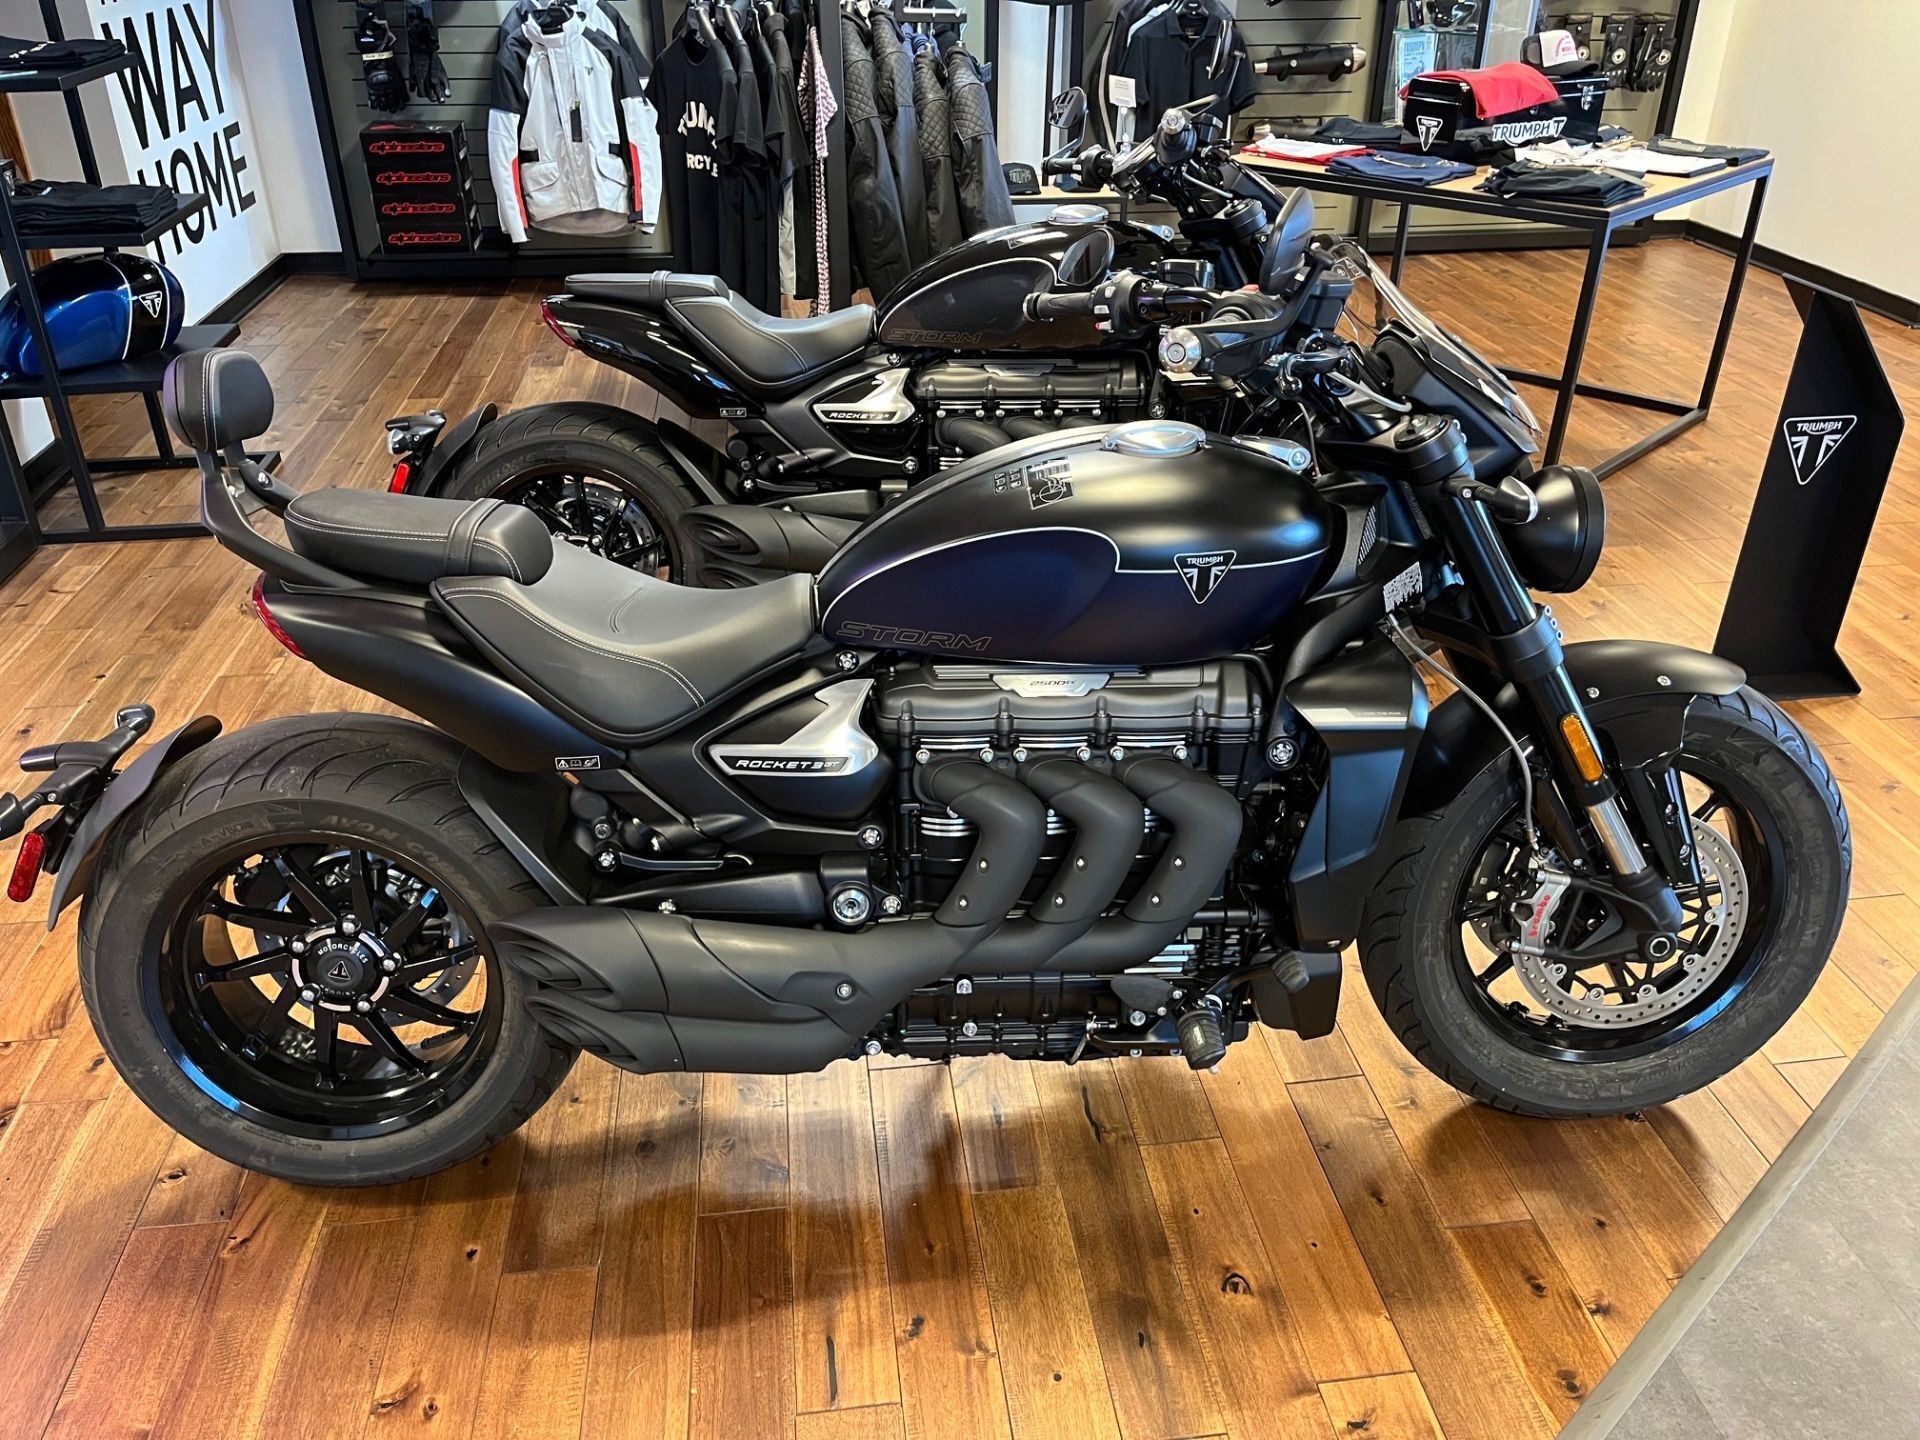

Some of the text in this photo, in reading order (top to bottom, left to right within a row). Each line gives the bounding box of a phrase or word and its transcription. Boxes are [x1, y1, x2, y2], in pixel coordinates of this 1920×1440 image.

[101, 0, 225, 151] WAY
[1492, 121, 1550, 146] TRIUMPH
[887, 328, 984, 345] STORM
[1796, 421, 1843, 435] TRIUMPH
[1186, 555, 1224, 567] TRIUMPH
[836, 620, 993, 651] STORM
[1527, 894, 1551, 937] brembo
[317, 942, 369, 964] MOTORCYCLES
